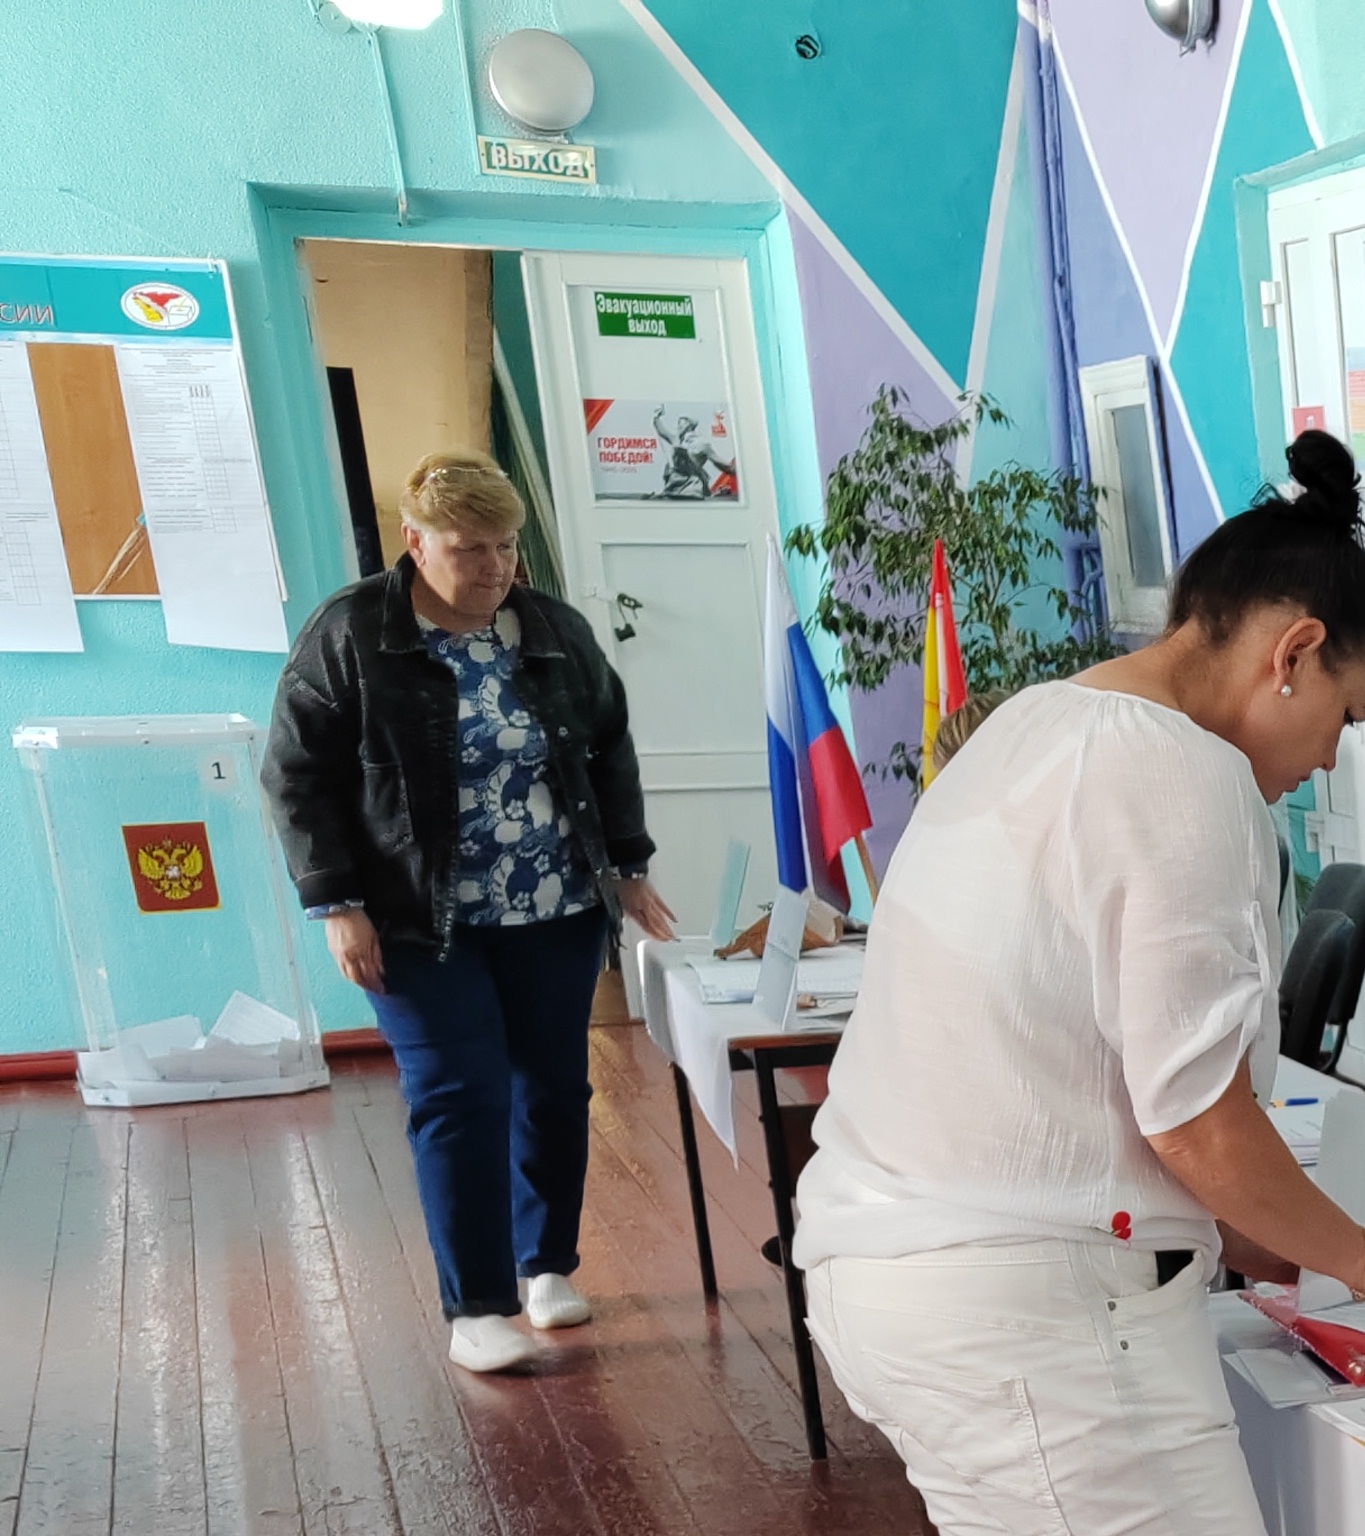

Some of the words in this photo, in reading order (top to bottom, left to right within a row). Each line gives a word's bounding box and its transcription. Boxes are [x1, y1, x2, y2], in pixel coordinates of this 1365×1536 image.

[490, 143, 586, 177] ВЫХОД
[595, 293, 693, 319] Эвакуационный
[627, 319, 667, 337] выход
[597, 437, 657, 450] ГОРДИМСЯ
[599, 451, 653, 465] ПОБЕДОЙ!
[211, 761, 227, 780] 1
